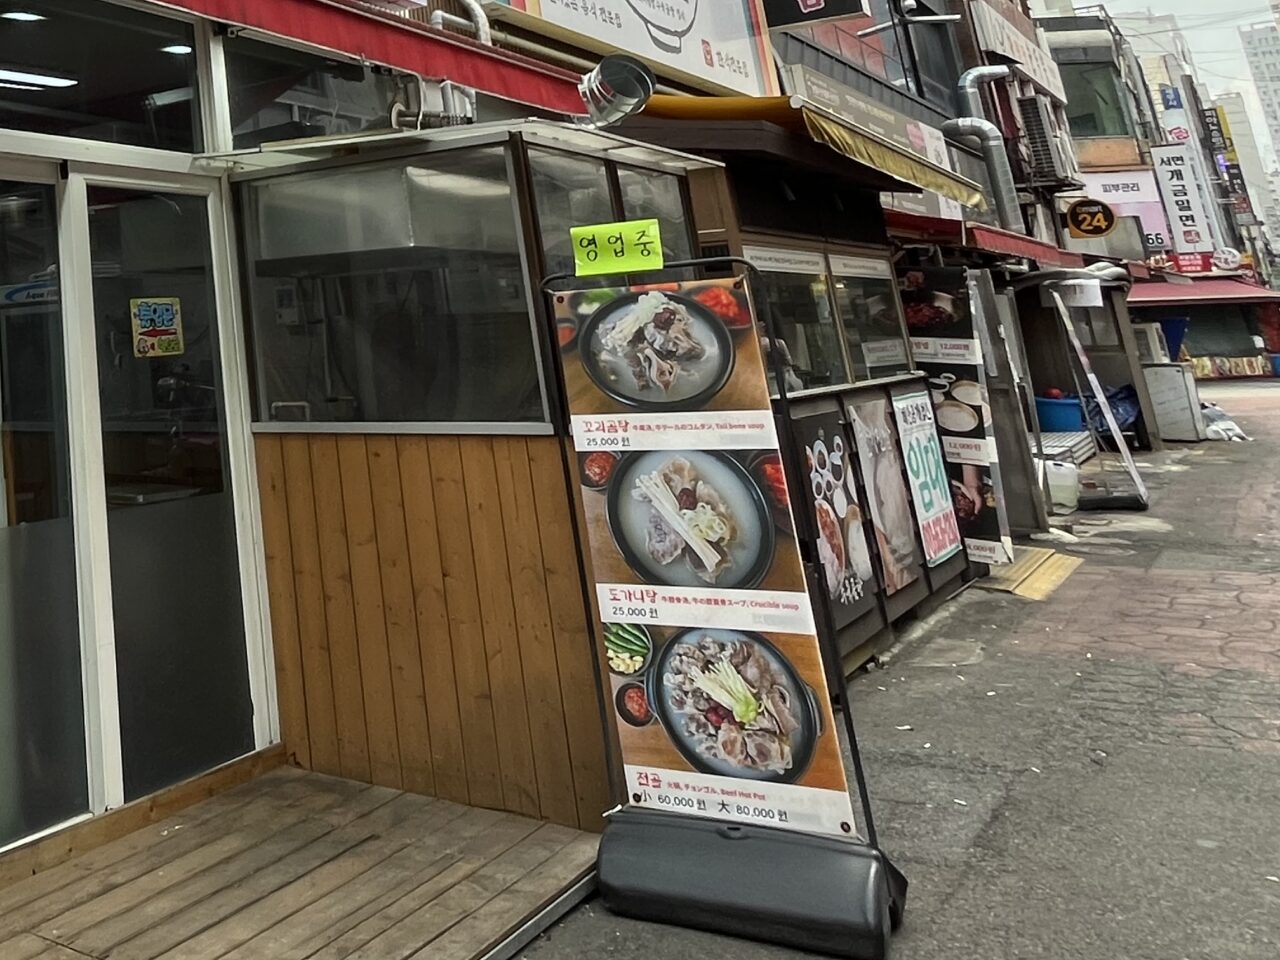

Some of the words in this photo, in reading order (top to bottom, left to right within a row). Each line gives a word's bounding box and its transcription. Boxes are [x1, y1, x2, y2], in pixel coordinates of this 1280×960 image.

[1159, 155, 1185, 167] 서면
[1102, 182, 1140, 193] 피부관리
[1168, 169, 1197, 229] 개금밀면
[1078, 212, 1109, 230] 24
[578, 230, 655, 261] 영업중
[582, 419, 630, 434] 꼬리곰탕
[586, 437, 619, 447] 25,000
[621, 436, 631, 447] 원
[609, 588, 658, 604] 도가니탕
[612, 606, 647, 618] 25,000
[649, 607, 659, 619] 원
[636, 771, 662, 789] 전골
[658, 793, 694, 808] 60,000
[696, 798, 707, 811] 원
[718, 799, 731, 814] 大
[736, 804, 775, 820] 80,000
[778, 809, 789, 822] 원
